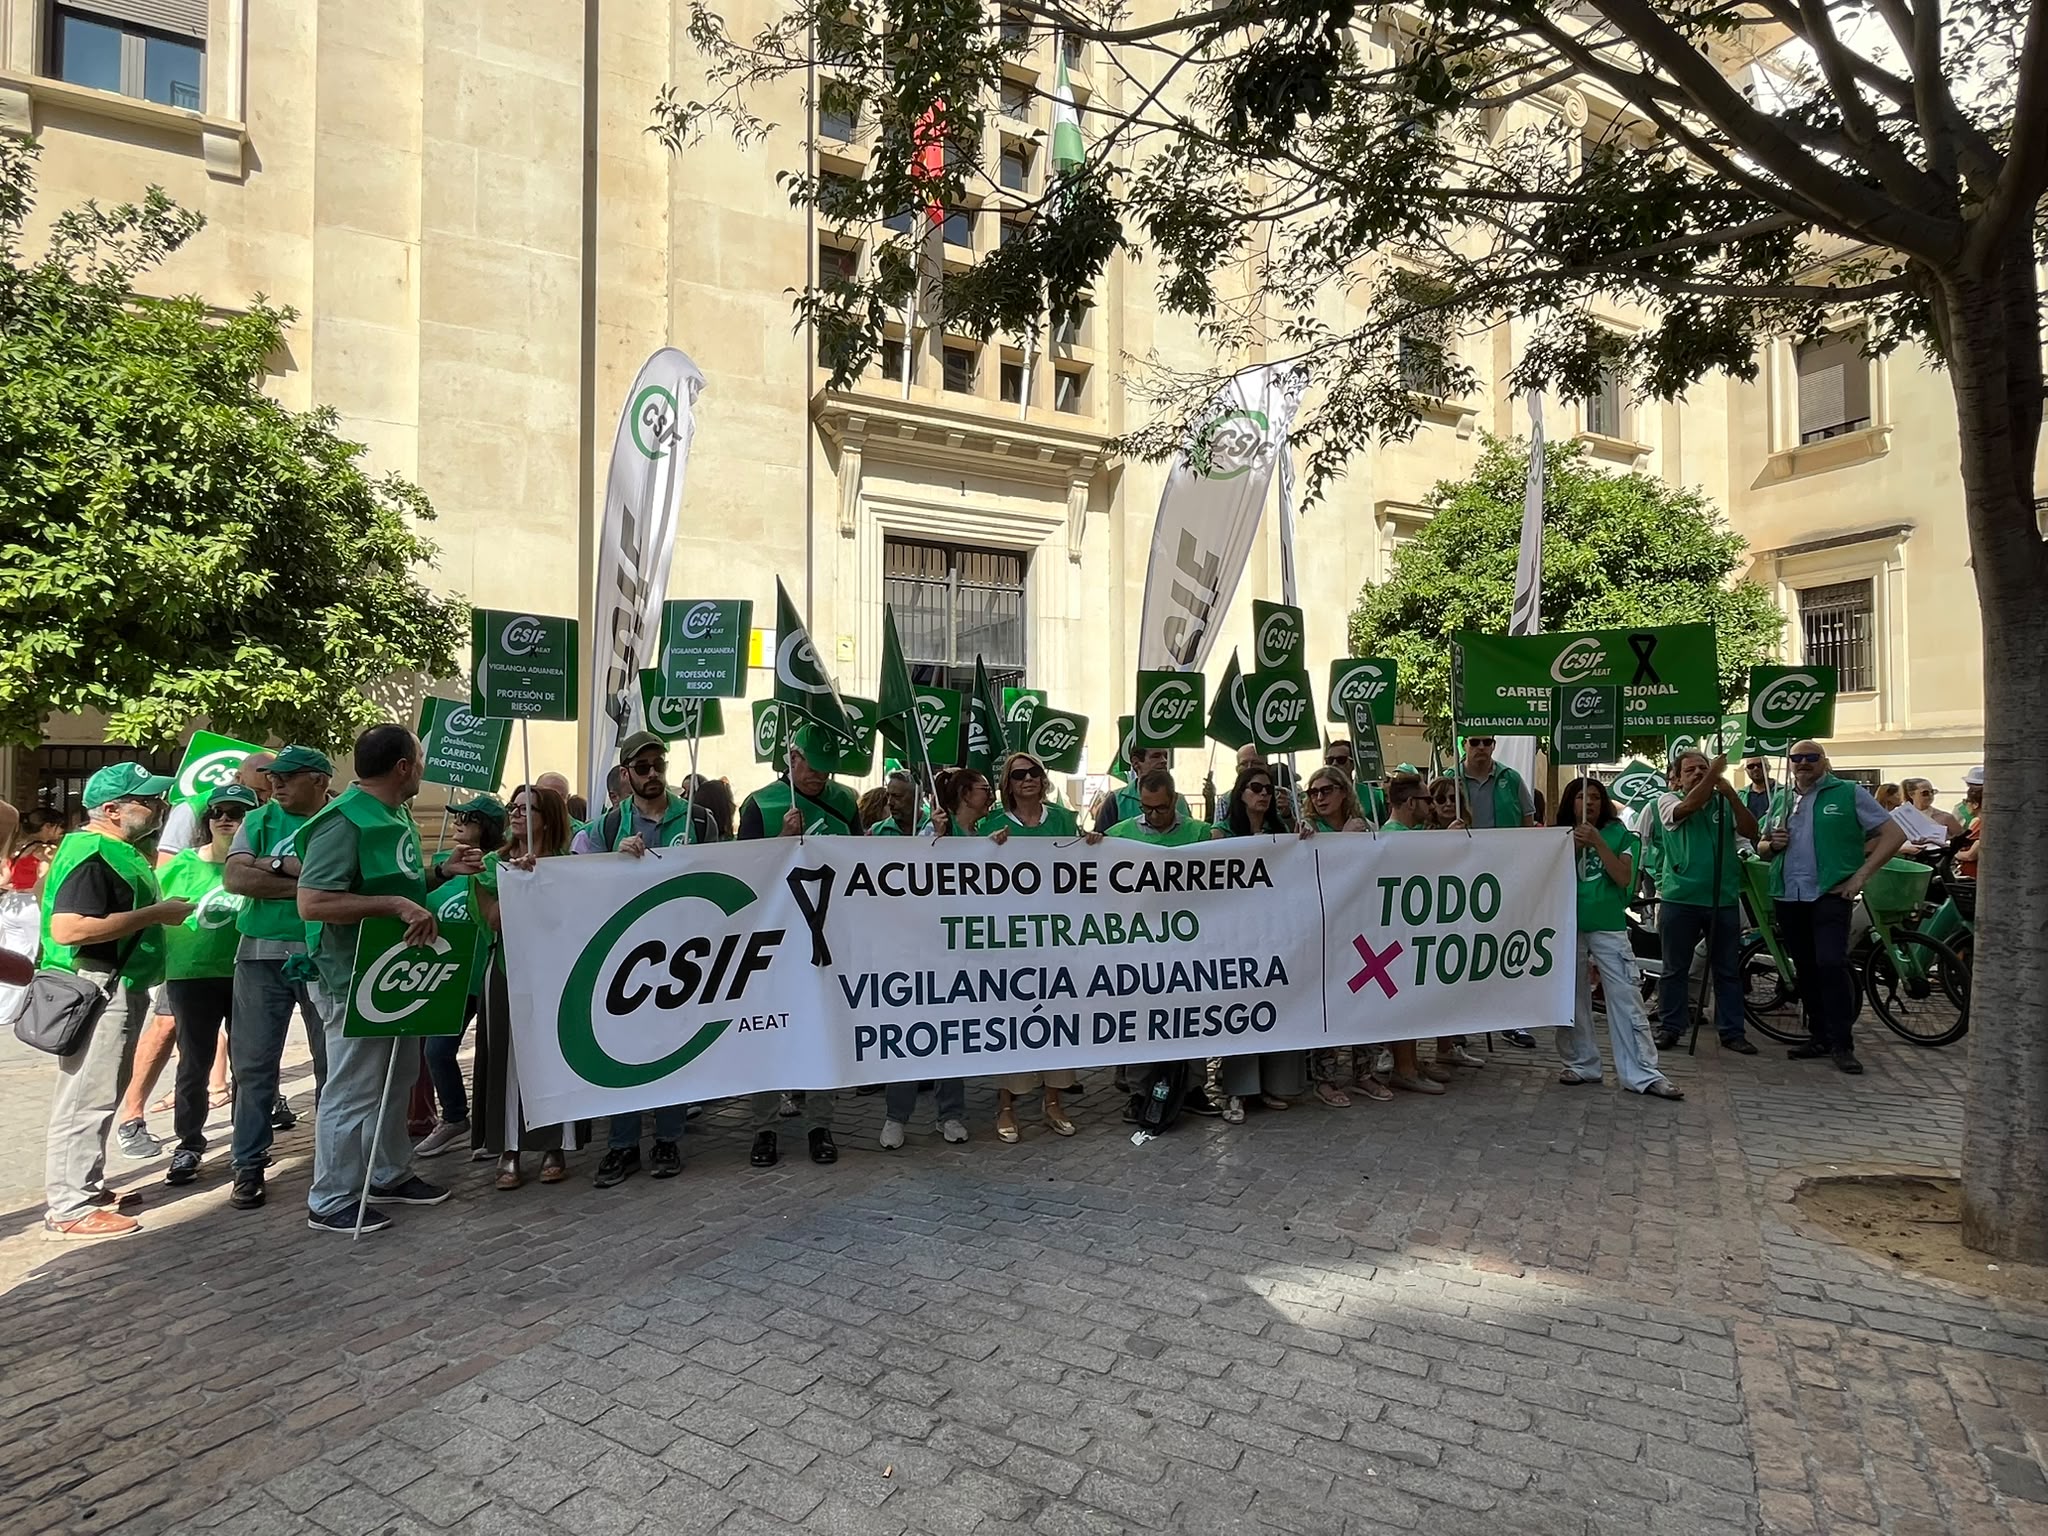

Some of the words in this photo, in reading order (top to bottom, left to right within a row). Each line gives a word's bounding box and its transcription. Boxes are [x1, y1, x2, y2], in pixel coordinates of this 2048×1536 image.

[687, 612, 722, 627] CSIF
[508, 627, 547, 644] CSIF
[1264, 627, 1299, 650] CSIF
[488, 663, 527, 672] VIGILANCIA
[527, 666, 564, 676] ADUANERA
[1562, 651, 1607, 670] CSIF
[675, 669, 715, 678] PROFESIÓN
[717, 670, 726, 678] DE
[1591, 667, 1612, 676] AEAT
[496, 688, 544, 700] PROFESIÓN
[545, 692, 556, 700] DE
[686, 681, 714, 690] RIESGO
[1342, 680, 1389, 699] CSIF
[1623, 683, 1679, 697] SIONAL
[511, 701, 541, 712] RIESGO
[1151, 697, 1198, 720] CSIF
[1264, 698, 1306, 723] CSIF
[1576, 695, 1603, 709] CSIF
[1765, 690, 1826, 712] CSIF
[453, 713, 487, 728] CSIF
[1464, 717, 1524, 727] VIGILANCIA
[1656, 716, 1671, 725] DE
[1673, 715, 1716, 725] RIESGO
[1038, 730, 1080, 750] CSIF
[441, 747, 482, 761] CARRERA
[428, 757, 489, 775] PROFESIONAL
[449, 773, 464, 784] YA!
[844, 862, 1042, 897] ACUERDO
[1053, 861, 1098, 894] DE
[1109, 858, 1274, 893] CARRERA
[1377, 872, 1502, 927] TODO
[940, 910, 1200, 950] TELETRABAJO
[1411, 927, 1557, 987] TOD@S
[378, 960, 460, 992] CSIF
[605, 929, 786, 1016] CSIF
[838, 966, 1078, 1009] VIGILANCIA
[1086, 955, 1289, 998] ADUANERA
[738, 1013, 790, 1033] AEAT
[854, 1003, 1080, 1062] PROFESIÓN
[1092, 1010, 1137, 1045] DE
[1148, 1000, 1277, 1041] RIESGO
